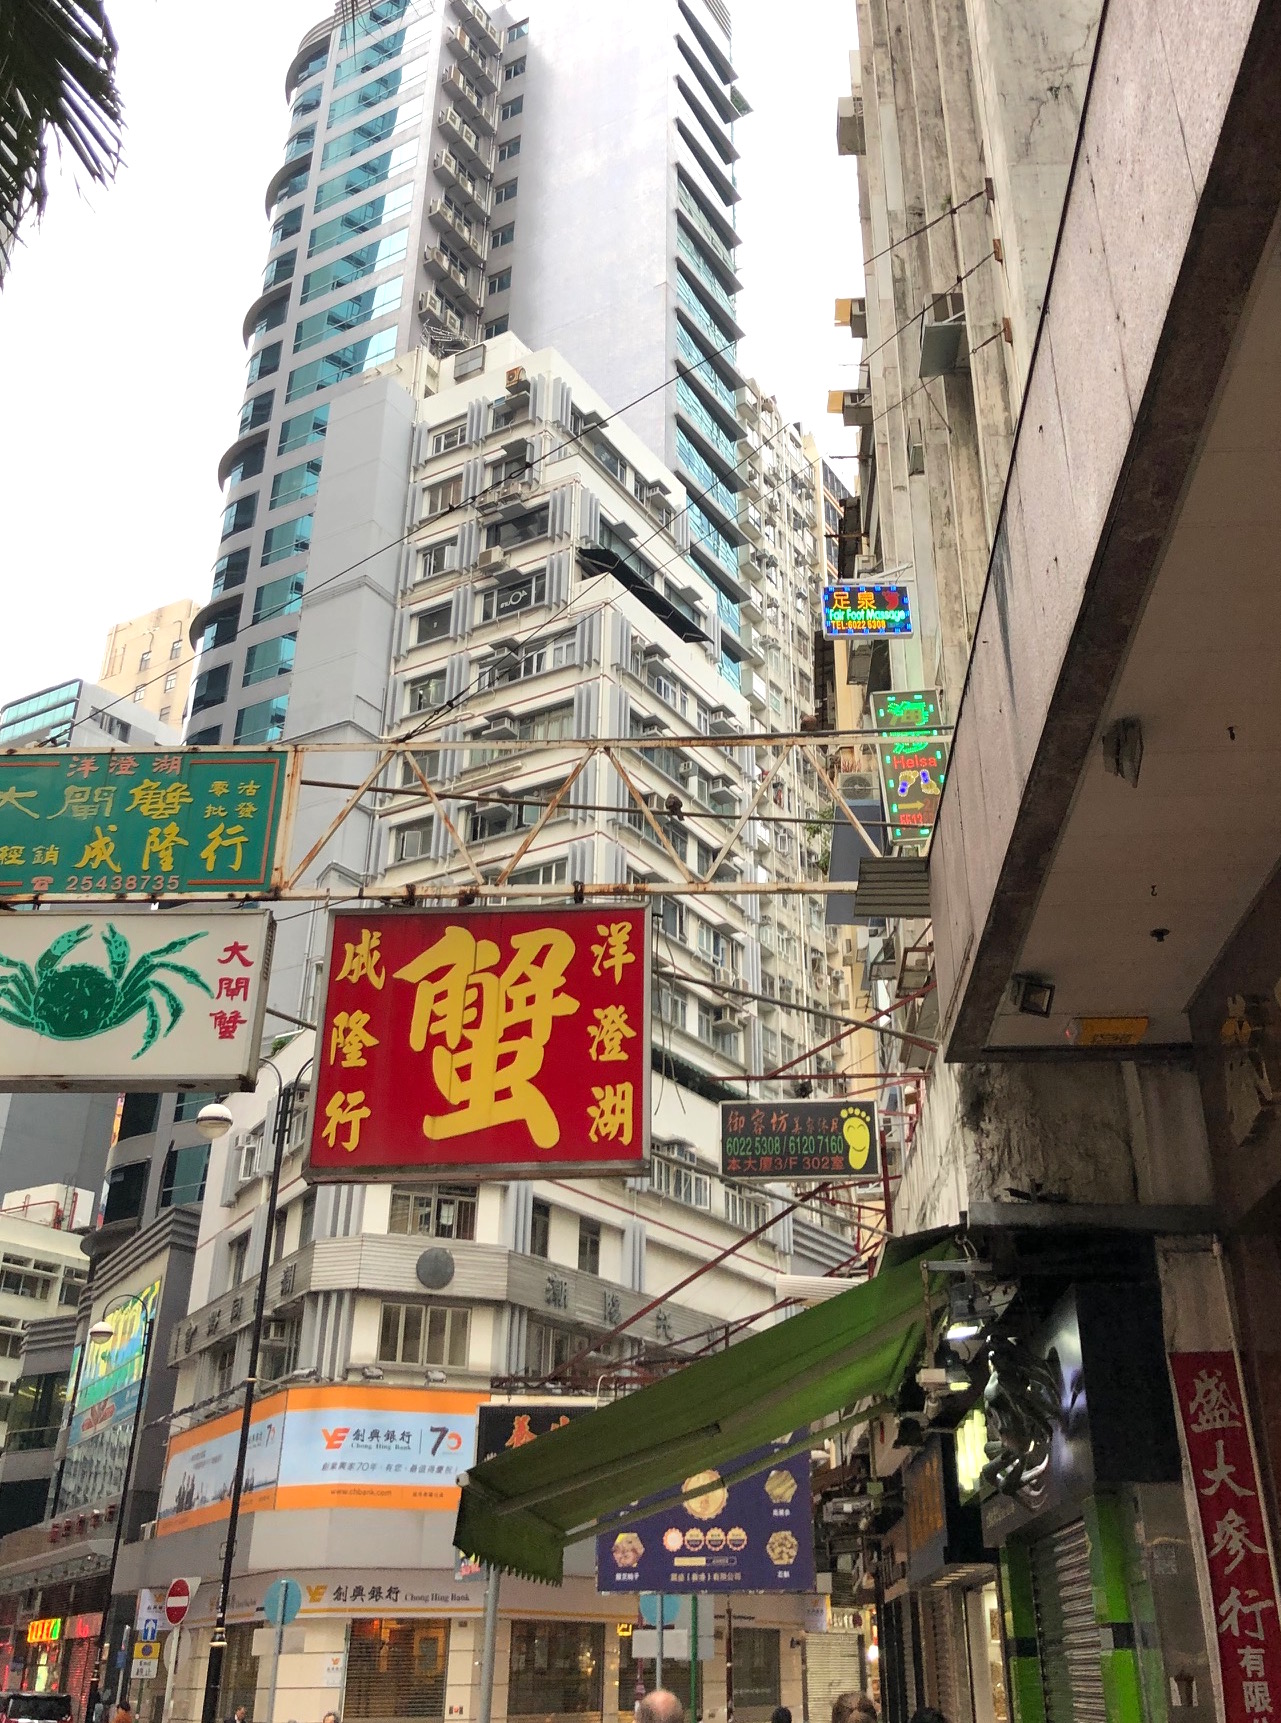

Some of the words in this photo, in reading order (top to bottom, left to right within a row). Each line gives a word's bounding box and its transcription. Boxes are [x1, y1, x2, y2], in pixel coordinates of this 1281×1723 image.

[833, 591, 876, 609] 足泉
[829, 609, 845, 620] Fair
[846, 609, 864, 620] Foot
[866, 609, 905, 622] Massage
[66, 755, 182, 779] 洋澄湖
[66, 875, 180, 892] 25438735
[322, 928, 386, 1152] 成隆行
[392, 925, 581, 1149] 蟹
[587, 922, 637, 1146] 洋澄湖
[726, 1137, 752, 1156] 6022
[754, 1136, 780, 1155] 5308
[788, 1136, 815, 1155] 6120
[818, 1135, 844, 1154] 7160
[333, 1585, 401, 1602] 創興銀行
[404, 1593, 430, 1602] Chong
[431, 1593, 450, 1602] Hing
[451, 1593, 470, 1601] Bank
